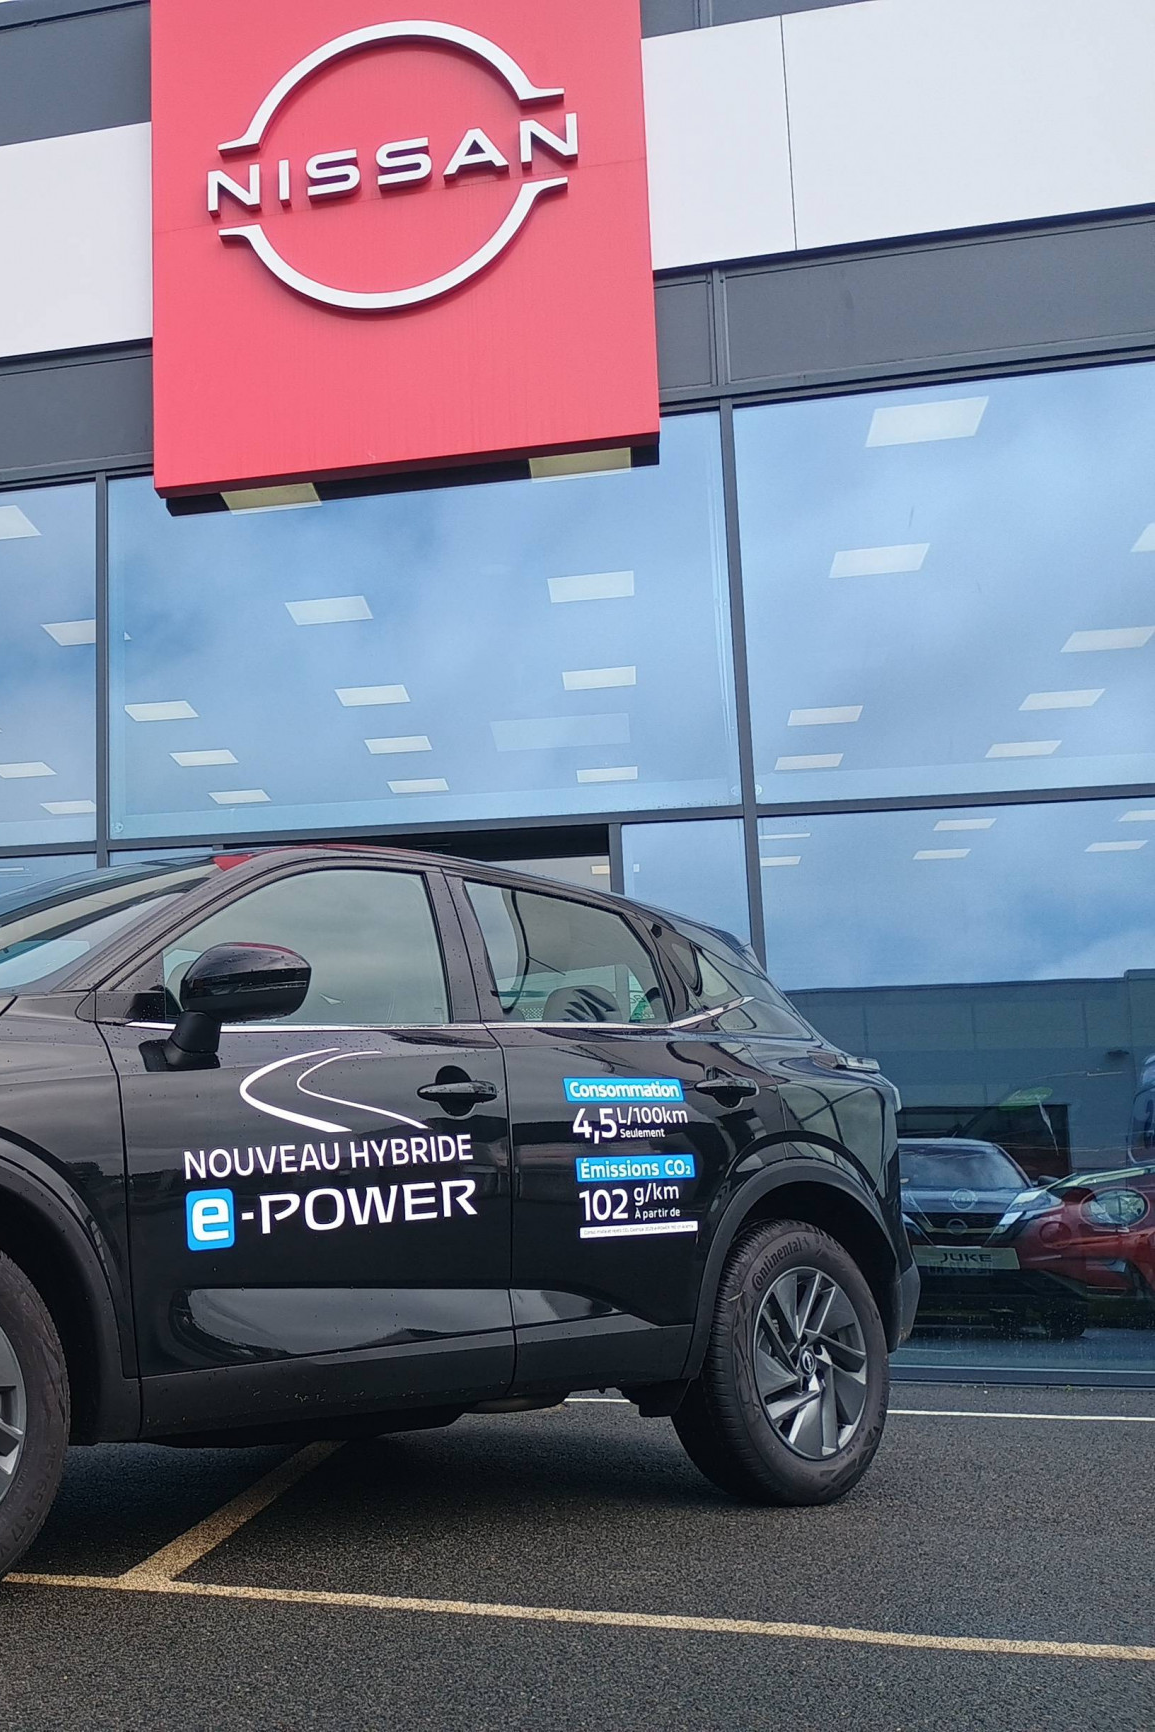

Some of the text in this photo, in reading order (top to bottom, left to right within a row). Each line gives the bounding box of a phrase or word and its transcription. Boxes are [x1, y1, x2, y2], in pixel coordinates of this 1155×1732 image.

[207, 112, 579, 217] NISSAN
[569, 1082, 680, 1099] Consommation
[572, 1107, 688, 1144] 4,5 L/100km
[620, 1127, 665, 1139] Seulement
[183, 1134, 473, 1179] NOUVEAU HYBRIDE
[581, 1157, 659, 1178] Émissions
[192, 1179, 478, 1242] e-POWER
[579, 1183, 680, 1221] 102 g/km
[634, 1208, 681, 1221] À partir de
[751, 1238, 803, 1291] Continental
[941, 1252, 993, 1263] JUKE
